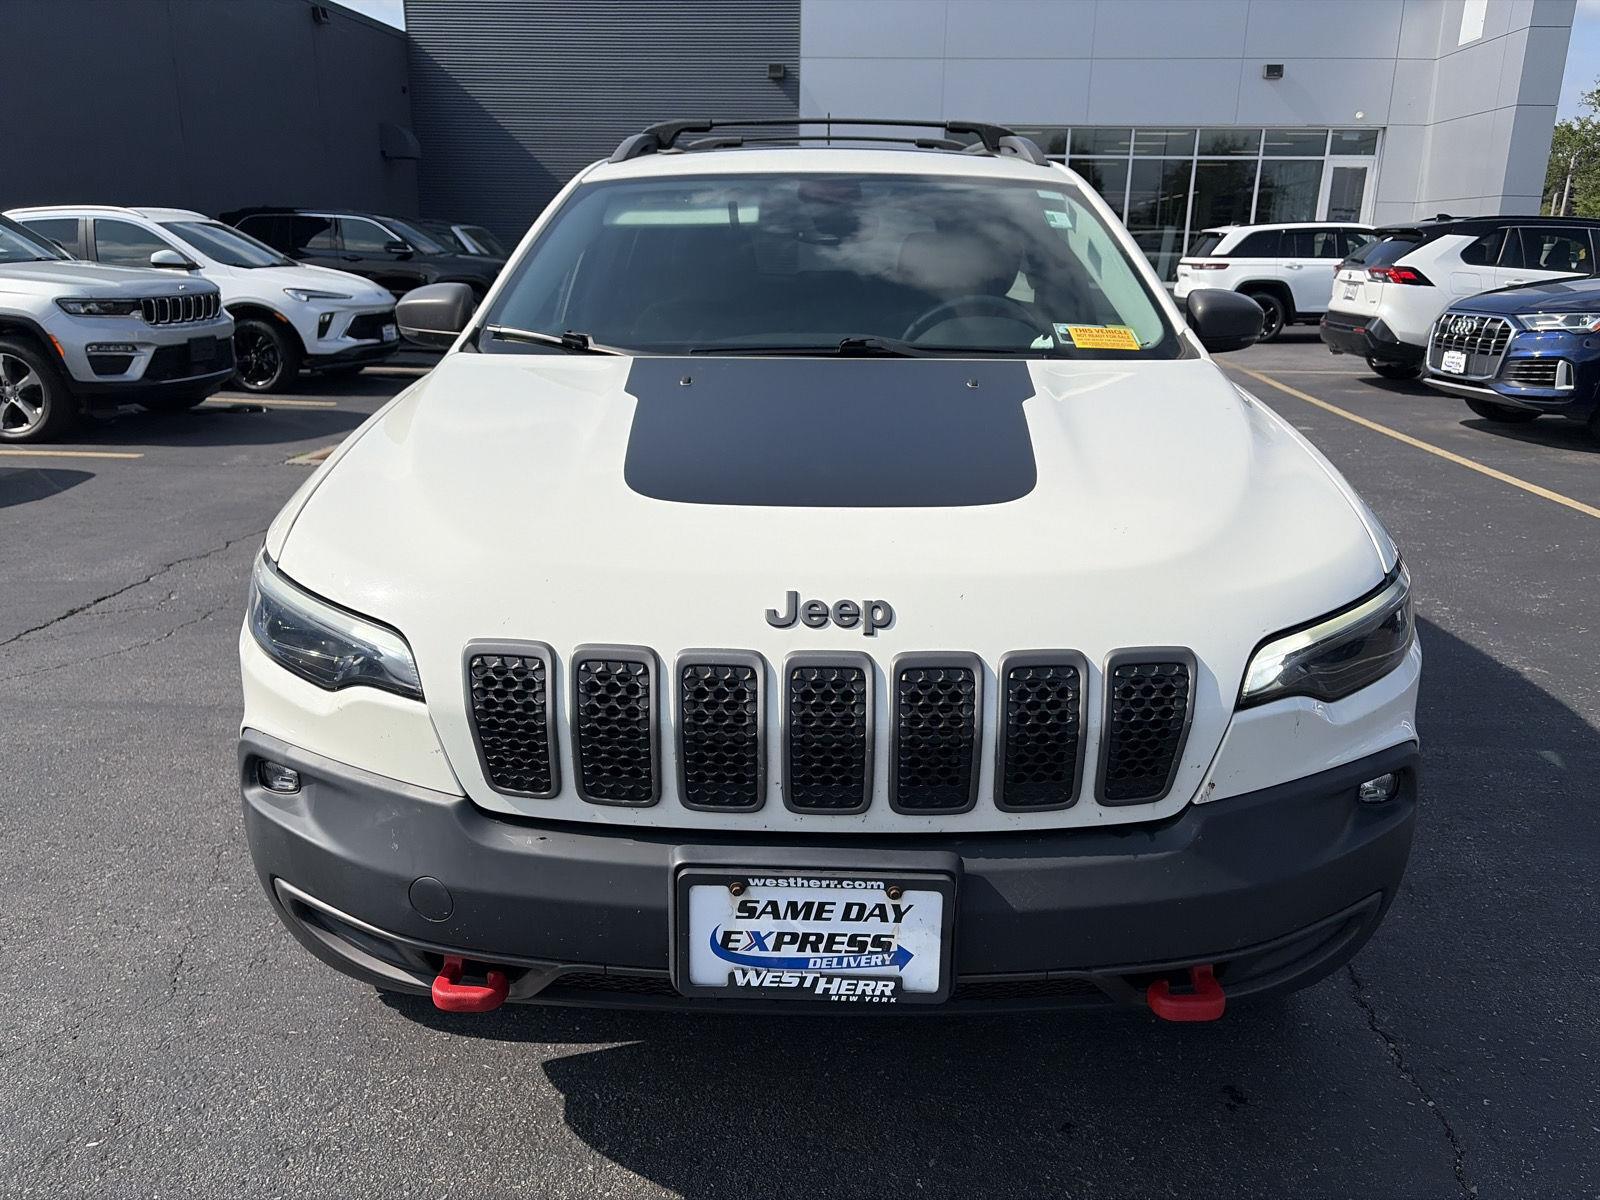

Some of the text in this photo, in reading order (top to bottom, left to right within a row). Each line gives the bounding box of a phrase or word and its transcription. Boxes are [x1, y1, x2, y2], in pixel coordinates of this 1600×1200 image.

[765, 590, 895, 636] Jeep
[748, 877, 885, 889] westherr.com
[735, 899, 914, 923] SAME DAY
[719, 930, 895, 954] EXPRESS
[808, 953, 894, 969] DELIVERY
